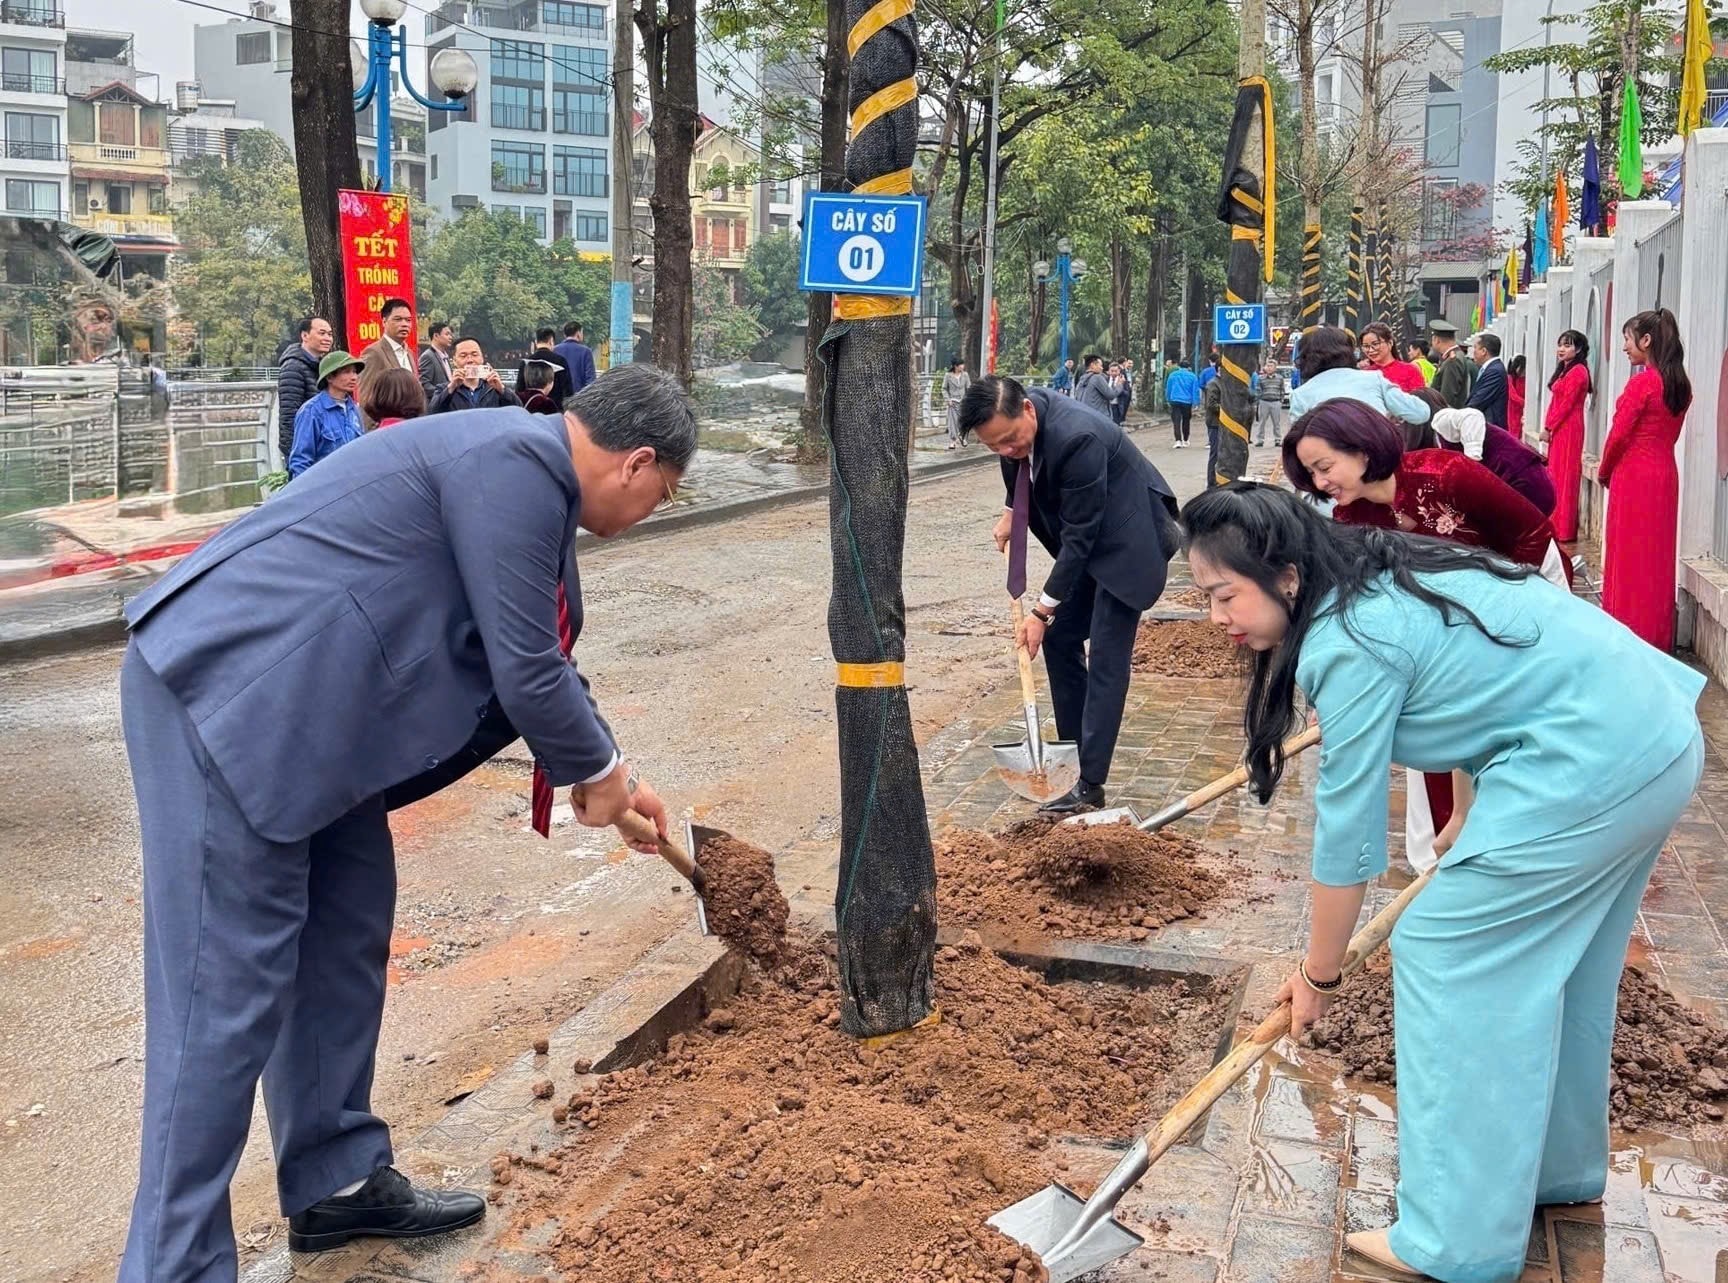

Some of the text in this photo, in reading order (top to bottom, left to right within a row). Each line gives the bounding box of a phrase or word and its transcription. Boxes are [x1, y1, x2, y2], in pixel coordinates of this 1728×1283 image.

[831, 207, 897, 233] CÂY SỐ
[354, 229, 398, 258] TẾT
[849, 246, 873, 270] 01
[358, 263, 399, 285] TRỒNG
[368, 293, 393, 312] CÂ
[1225, 309, 1241, 320] CÂY
[1233, 324, 1245, 334] 02
